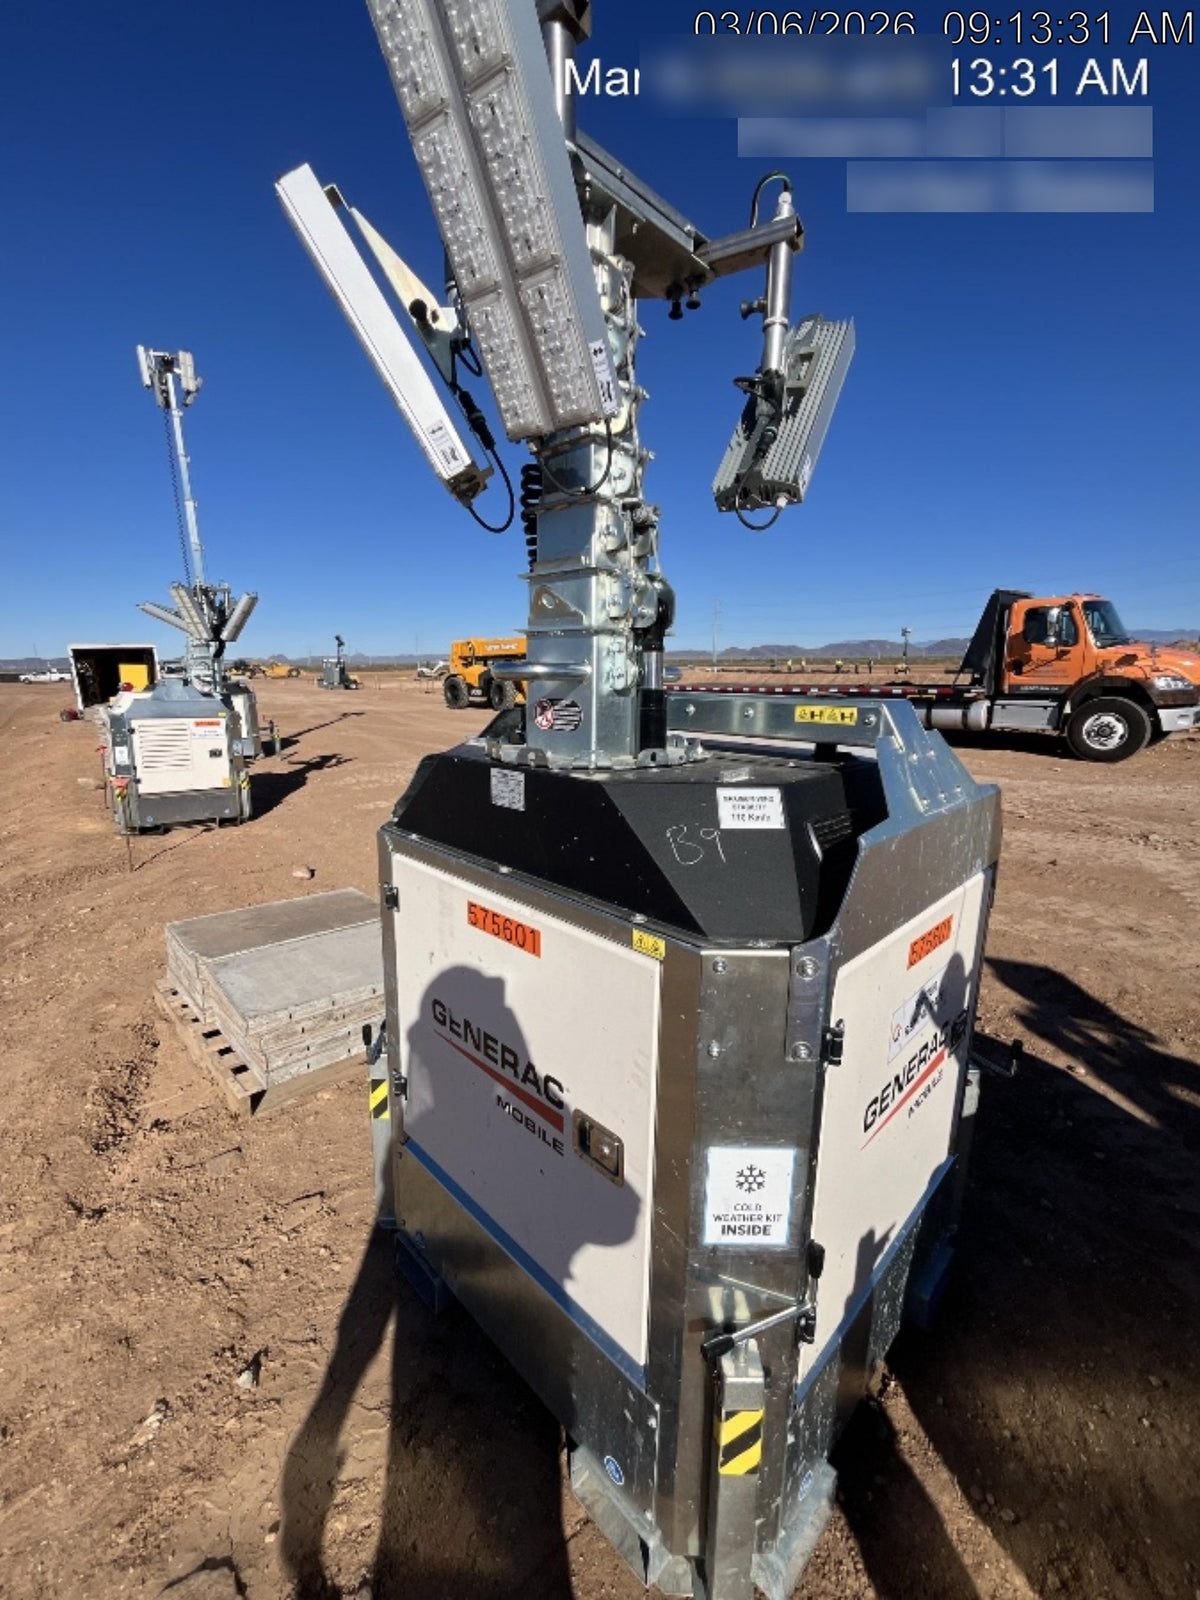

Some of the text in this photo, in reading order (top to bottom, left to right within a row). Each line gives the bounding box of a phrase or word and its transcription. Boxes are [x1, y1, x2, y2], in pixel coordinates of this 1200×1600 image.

[468, 902, 537, 955] 575601
[431, 998, 565, 1110] GENERAC
[496, 1094, 565, 1157] MOBILE
[713, 1213, 783, 1222] WEATHER KIT
[733, 1203, 762, 1212] COLD
[721, 1224, 772, 1237] INSIDE
